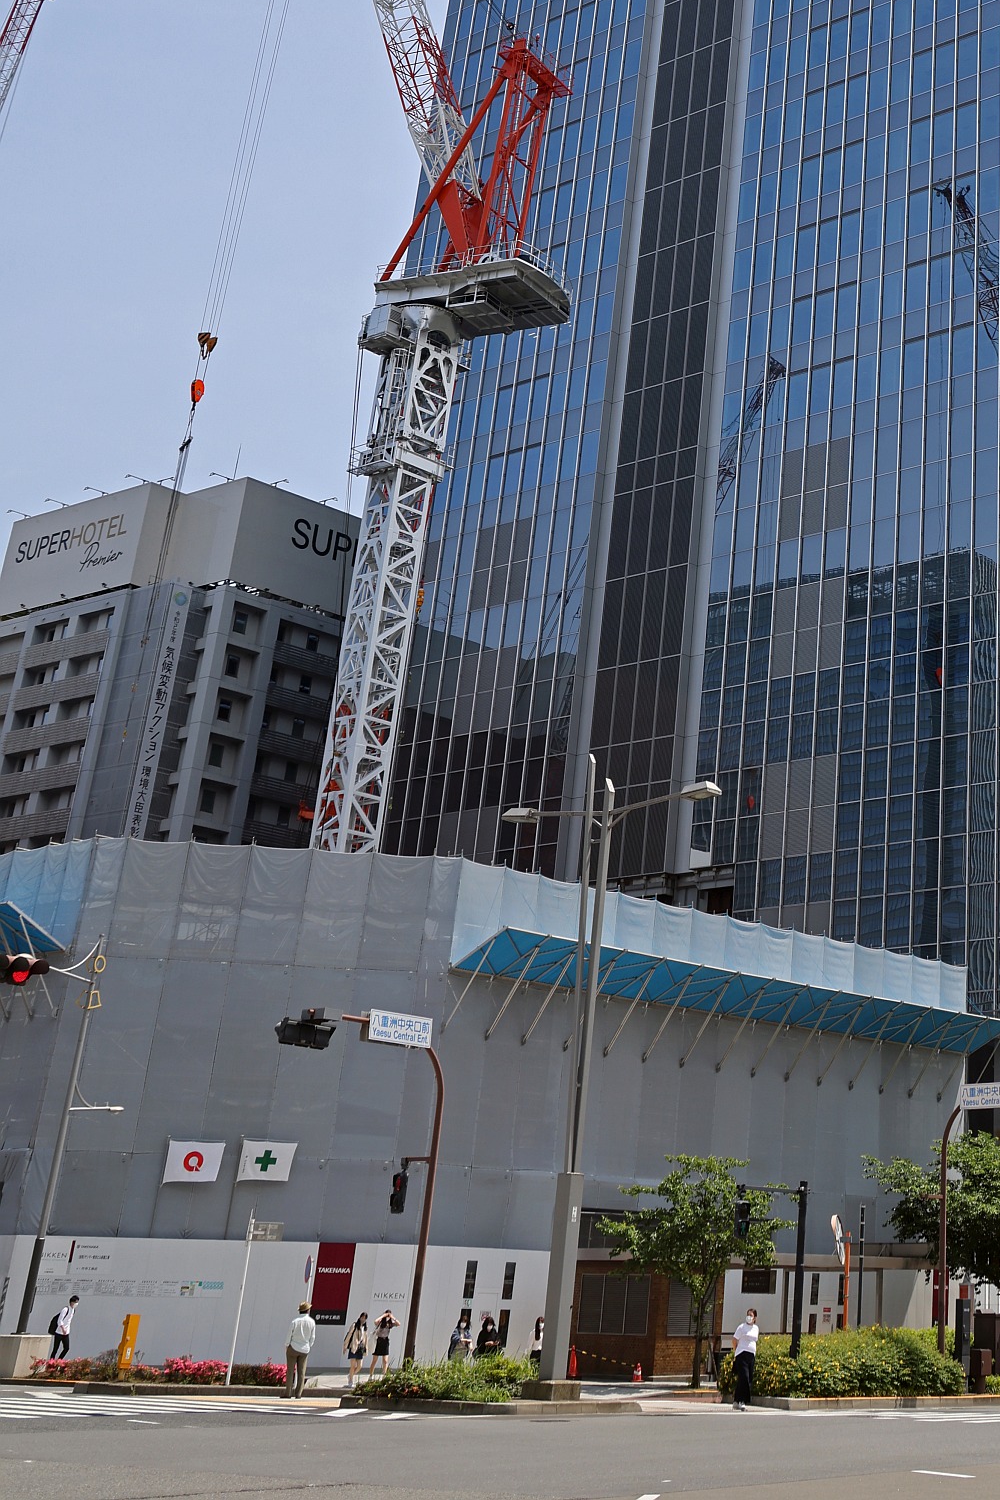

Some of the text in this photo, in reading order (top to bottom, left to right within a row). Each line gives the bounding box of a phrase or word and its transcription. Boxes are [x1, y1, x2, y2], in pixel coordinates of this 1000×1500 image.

[15, 514, 127, 563] SUPERHOTEL
[79, 541, 123, 572] Premier
[145, 645, 175, 761] 気候変動アクション
[372, 1014, 430, 1034] 八重洲中央口前
[372, 1027, 392, 1038] Yaesu
[393, 1030, 416, 1042] Central
